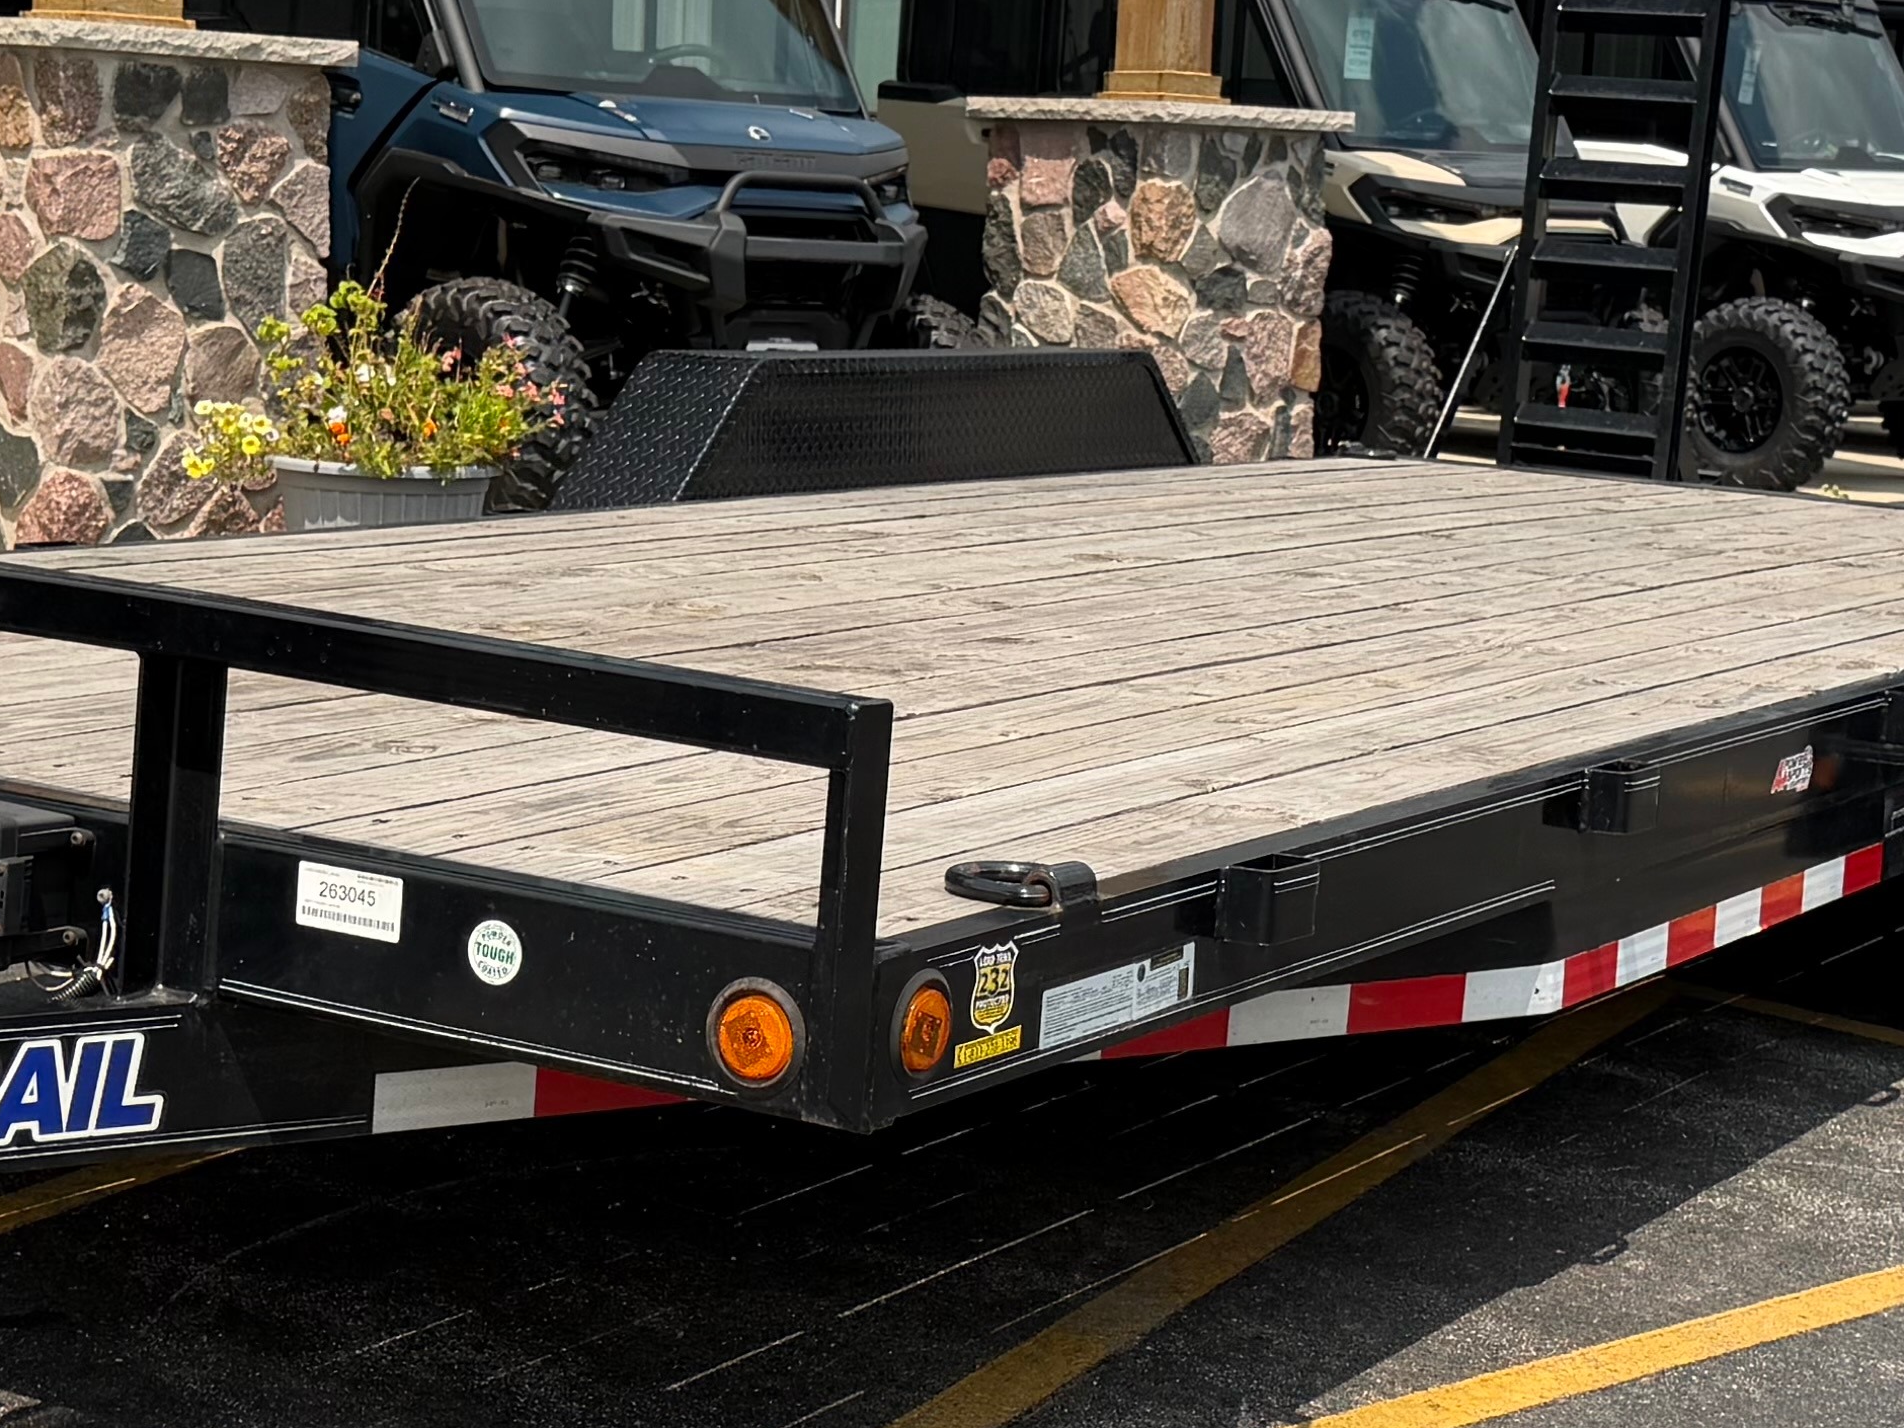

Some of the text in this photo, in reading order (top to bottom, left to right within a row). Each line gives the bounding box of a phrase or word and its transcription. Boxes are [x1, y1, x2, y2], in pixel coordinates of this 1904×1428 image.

[319, 880, 377, 907] 263045
[474, 941, 515, 965] TOUGH
[978, 967, 1009, 995] 232
